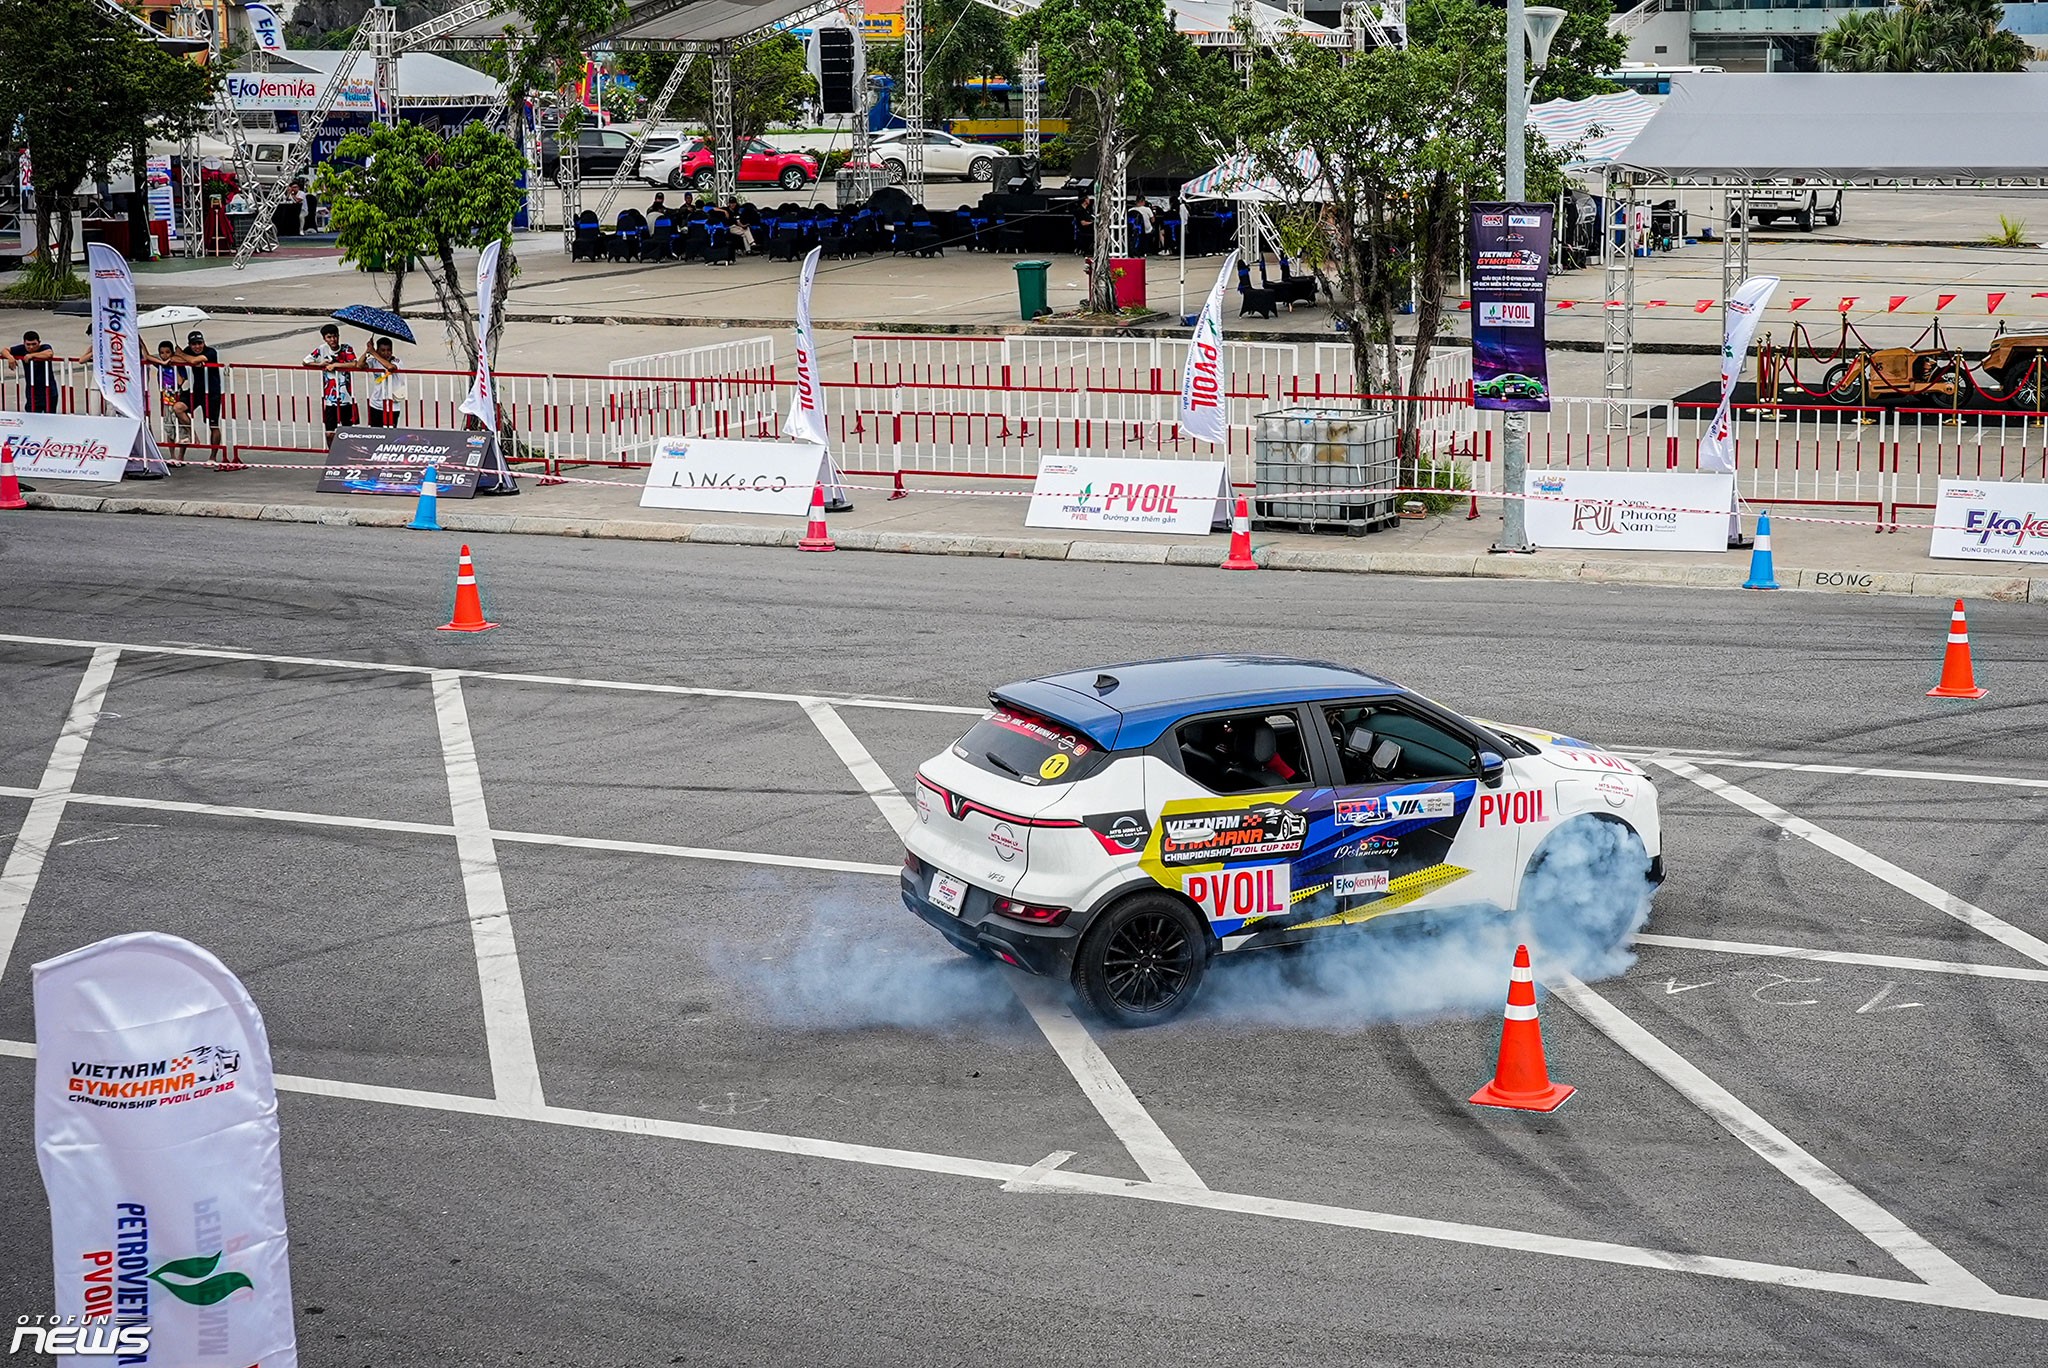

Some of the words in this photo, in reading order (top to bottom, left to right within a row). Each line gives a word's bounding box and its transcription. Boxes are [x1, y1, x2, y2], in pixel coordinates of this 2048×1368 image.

[229, 79, 315, 98] Ekokemika
[318, 127, 347, 137] DUNG
[1502, 305, 1530, 319] PVOIL
[103, 298, 129, 393] Ekokemika
[797, 349, 815, 411] PVOIL
[1191, 342, 1218, 411] PVOIL
[375, 444, 450, 454] ANNIVERSARY
[370, 453, 406, 462] MEGA
[407, 454, 447, 463] OFFER
[345, 470, 361, 480] 22
[402, 472, 412, 482] 9
[452, 474, 466, 484] 16
[1105, 483, 1178, 513] PVOIL
[1062, 505, 1101, 514] PETROVIETNAM
[1071, 512, 1088, 521] PVOIL
[1142, 514, 1160, 522] thêm
[1620, 521, 1653, 532] Nam
[1045, 758, 1065, 774] 11
[1560, 750, 1632, 772] PVOIL
[1479, 790, 1549, 828] PVOIL
[1165, 815, 1240, 833] VIETNAM
[1164, 849, 1231, 862] CHAMPIONSHIP
[1232, 846, 1258, 854] PVOIL
[1260, 844, 1279, 852] CUP
[1281, 841, 1300, 850] 2025
[1189, 869, 1283, 917] PVOIL
[1336, 876, 1386, 893] Ekokemika
[71, 1060, 166, 1079] VIETNAM
[69, 1072, 196, 1098] GYMKHANA
[69, 1095, 157, 1109] CHAMPIONSHIP
[159, 1095, 191, 1106] PVOIL
[193, 1087, 213, 1099] CUP
[215, 1081, 234, 1093] 2025
